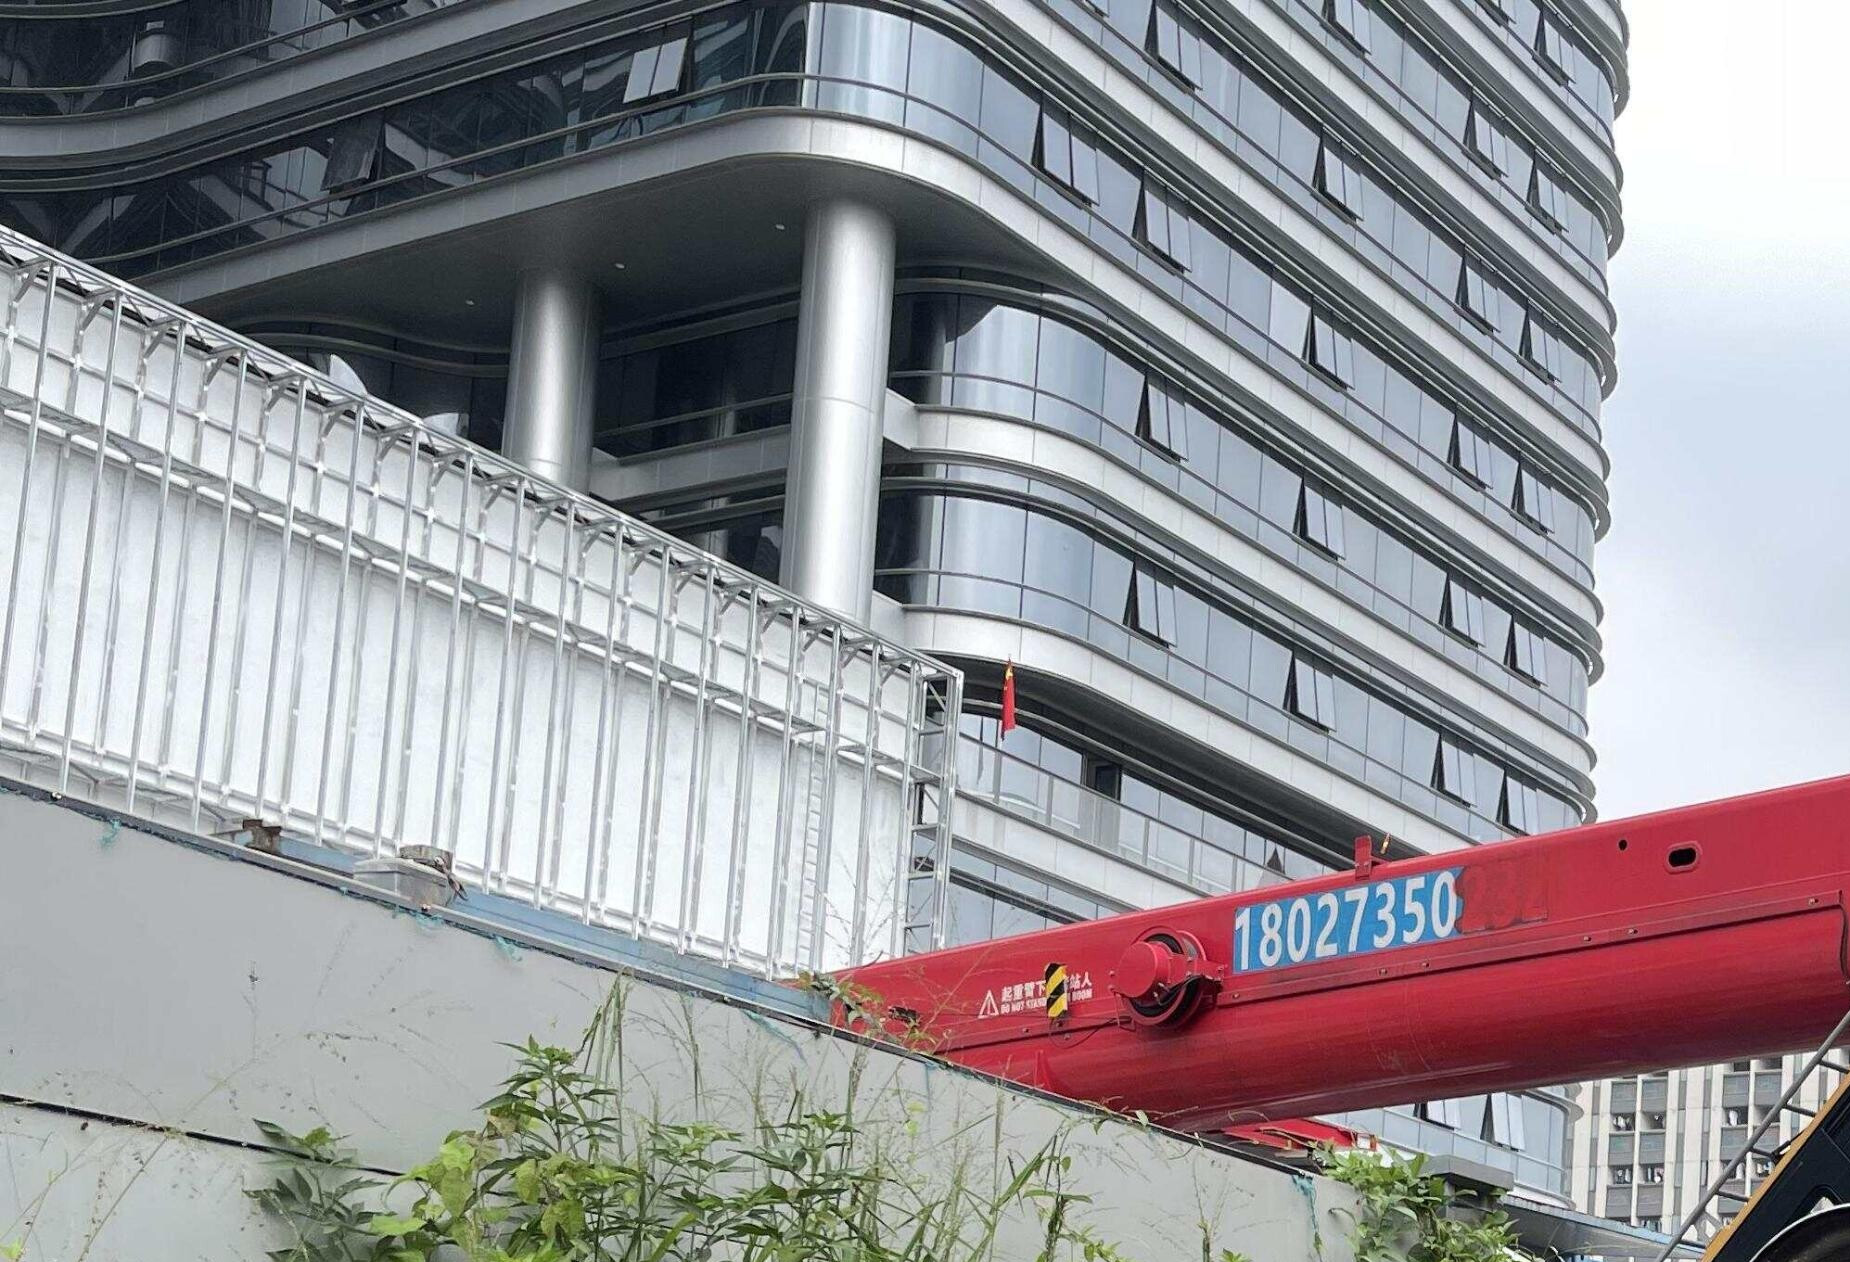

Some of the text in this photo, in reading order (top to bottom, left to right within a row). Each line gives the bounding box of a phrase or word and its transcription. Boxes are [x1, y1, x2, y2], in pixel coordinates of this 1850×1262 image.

[1235, 870, 1458, 971] 18027350
[1002, 971, 1092, 1001] 起重臂下站人
